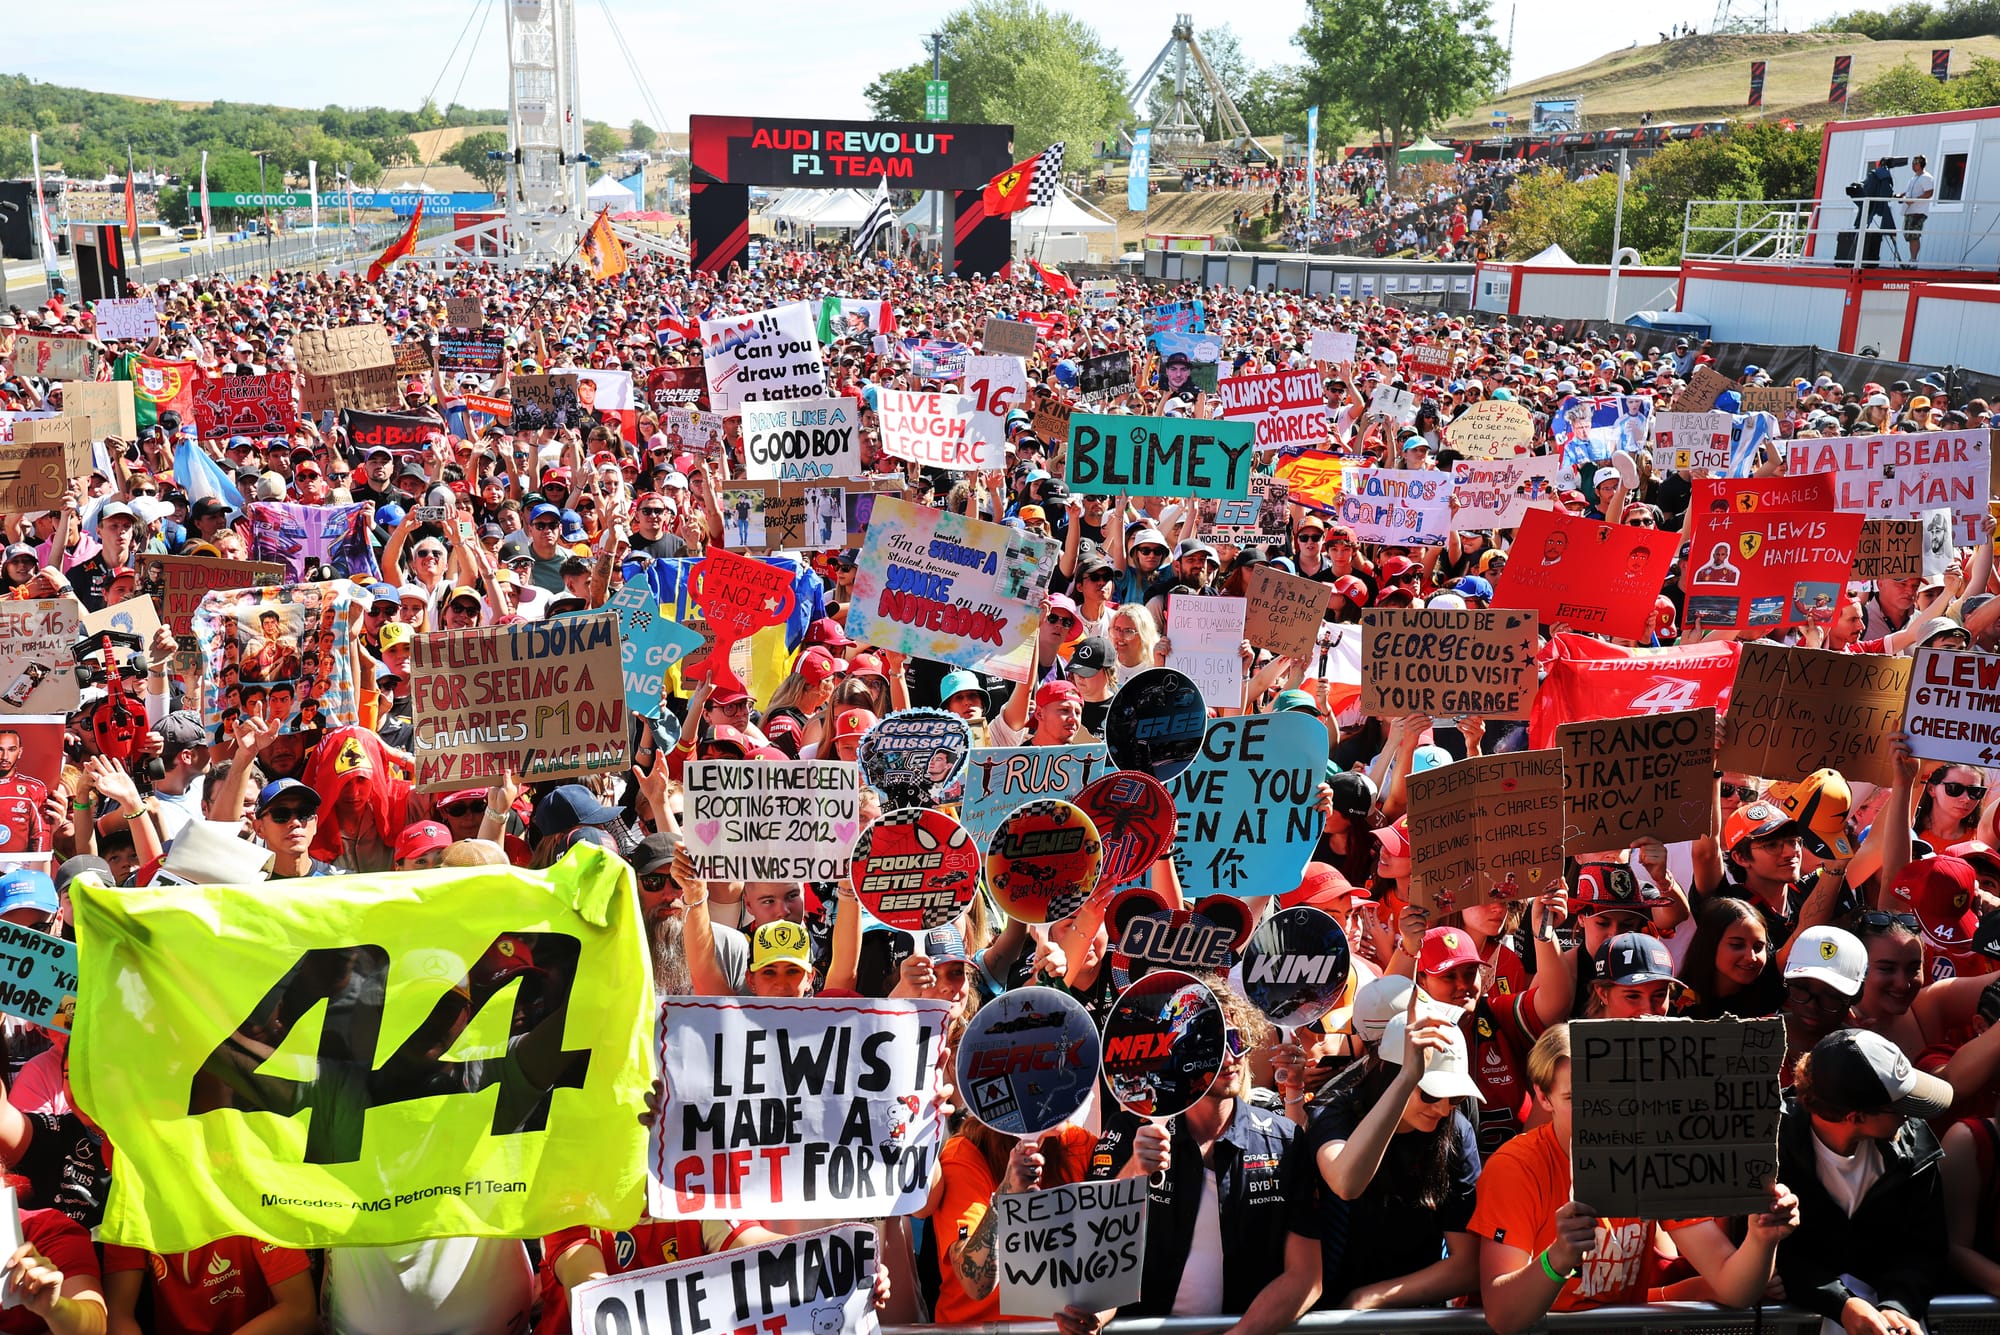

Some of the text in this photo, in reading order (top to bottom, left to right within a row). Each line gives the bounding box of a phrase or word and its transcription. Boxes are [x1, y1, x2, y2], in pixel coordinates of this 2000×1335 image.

[752, 128, 954, 155] AUDI REVOLUT
[792, 154, 913, 178] F1 TEAM
[235, 195, 297, 207] aramco
[316, 195, 373, 207] aramco
[391, 195, 450, 207] aramco
[734, 340, 811, 360] Can you
[1415, 346, 1449, 360] FERRARI
[225, 375, 266, 388] FORZA
[737, 365, 786, 383] draw
[793, 361, 820, 376] me
[221, 386, 267, 399] FERRARI
[654, 395, 699, 403] LECLERC
[655, 388, 701, 396] CHARLES
[745, 391, 756, 402] a
[971, 378, 1015, 417] 16
[1220, 372, 1322, 408] ALWAYS WITH
[883, 393, 941, 415] LIVE
[41, 421, 71, 433] MAX
[750, 407, 846, 432] DRIVE LIKE A
[884, 415, 966, 438] LAUGH
[1472, 421, 1483, 430] to
[750, 426, 852, 465] GOOD BOY
[886, 433, 986, 464] LECLERC
[1789, 438, 1969, 475] HALF BEAR
[771, 461, 819, 480] LIAM
[1691, 450, 1729, 469] SHOE
[1250, 478, 1270, 486] YOU
[1454, 463, 1524, 489] Simply
[1252, 486, 1265, 494] BE
[1708, 481, 1726, 497] 16
[1761, 487, 1819, 507] CHARLES
[1898, 476, 1974, 506] MAN
[1215, 495, 1263, 525] 63
[1708, 517, 1733, 533] 44
[1767, 521, 1826, 542] LEWIS
[1886, 520, 1916, 536] YOU
[915, 545, 925, 557] a
[1199, 535, 1282, 545] WORLD CHAMPION
[1886, 538, 1911, 553] MY
[1763, 547, 1852, 568] HAMILTON
[1851, 556, 1918, 579] PORTRAIT
[709, 557, 783, 593] FERRARI
[925, 561, 960, 580] because
[612, 587, 650, 609] 63
[955, 597, 1003, 620] on my
[878, 588, 1008, 647] NOTEBOOK
[1252, 597, 1314, 623] made this
[1379, 611, 1495, 631] IT WOULD BE
[1555, 603, 1609, 622] Ferrari
[40, 611, 65, 636] 16
[413, 630, 499, 668] I FLEW
[645, 644, 682, 667] GO
[1372, 632, 1515, 663] GEORGEOUS
[1205, 657, 1233, 675] SIGN
[1372, 664, 1525, 687] IF I COULD VISIT
[1588, 658, 1648, 672] LEWIS
[415, 663, 594, 713] FOR SEEING A
[1627, 677, 1702, 712] 44
[1916, 687, 1961, 709] 6TH
[1375, 686, 1519, 713] YOUR GARAGE
[416, 699, 624, 750] CHARLES P1 ON
[881, 720, 960, 735] George
[875, 735, 962, 753] Russell
[1732, 720, 1881, 756] YOU TO SIGN
[421, 739, 625, 785] MY DAY
[688, 765, 855, 792] LEWIS HAVE BEEN
[1005, 754, 1073, 795] RUS
[1248, 768, 1312, 806] YOU
[1654, 780, 1682, 801] ME
[696, 796, 854, 820] ROOTING FOR YOU
[1494, 796, 1559, 819] CHARLES
[725, 820, 836, 844] SINCE 2012
[1233, 808, 1268, 844] AI
[1485, 822, 1548, 844] CHARLES
[1592, 807, 1664, 837] A CAP
[754, 858, 790, 880] WAS
[866, 852, 943, 873] POOKIE
[945, 852, 976, 868] 31
[1490, 845, 1561, 871] CHARLES
[862, 872, 923, 893] ESTIE
[880, 891, 955, 911] BESTIE
[1121, 916, 1237, 968] OLLIE
[1934, 924, 1954, 941] 44
[1621, 949, 1633, 965] 1
[1247, 954, 1337, 984] KIMI
[1930, 959, 1954, 979] hp
[188, 931, 593, 1165] 44
[1104, 1031, 1179, 1063] MAX
[713, 1026, 896, 1098] LEWIS
[1726, 1055, 1771, 1075] FAIS
[1583, 1082, 1781, 1118] PAS COMME LES BLEUS
[682, 1096, 873, 1151] MADE A
[1656, 1115, 1756, 1143] LA COUPE
[1243, 1153, 1278, 1162] ORACLE
[1580, 1157, 1597, 1171] LA
[674, 1142, 876, 1214] GIFT FOR
[261, 1179, 528, 1214] Mercedes-AMG Petronas F1 Team
[1002, 1180, 1146, 1226] REDBULL
[1249, 1195, 1285, 1205] HONDA
[1005, 1212, 1140, 1253] GIVES YOU
[757, 1230, 876, 1316] MADE
